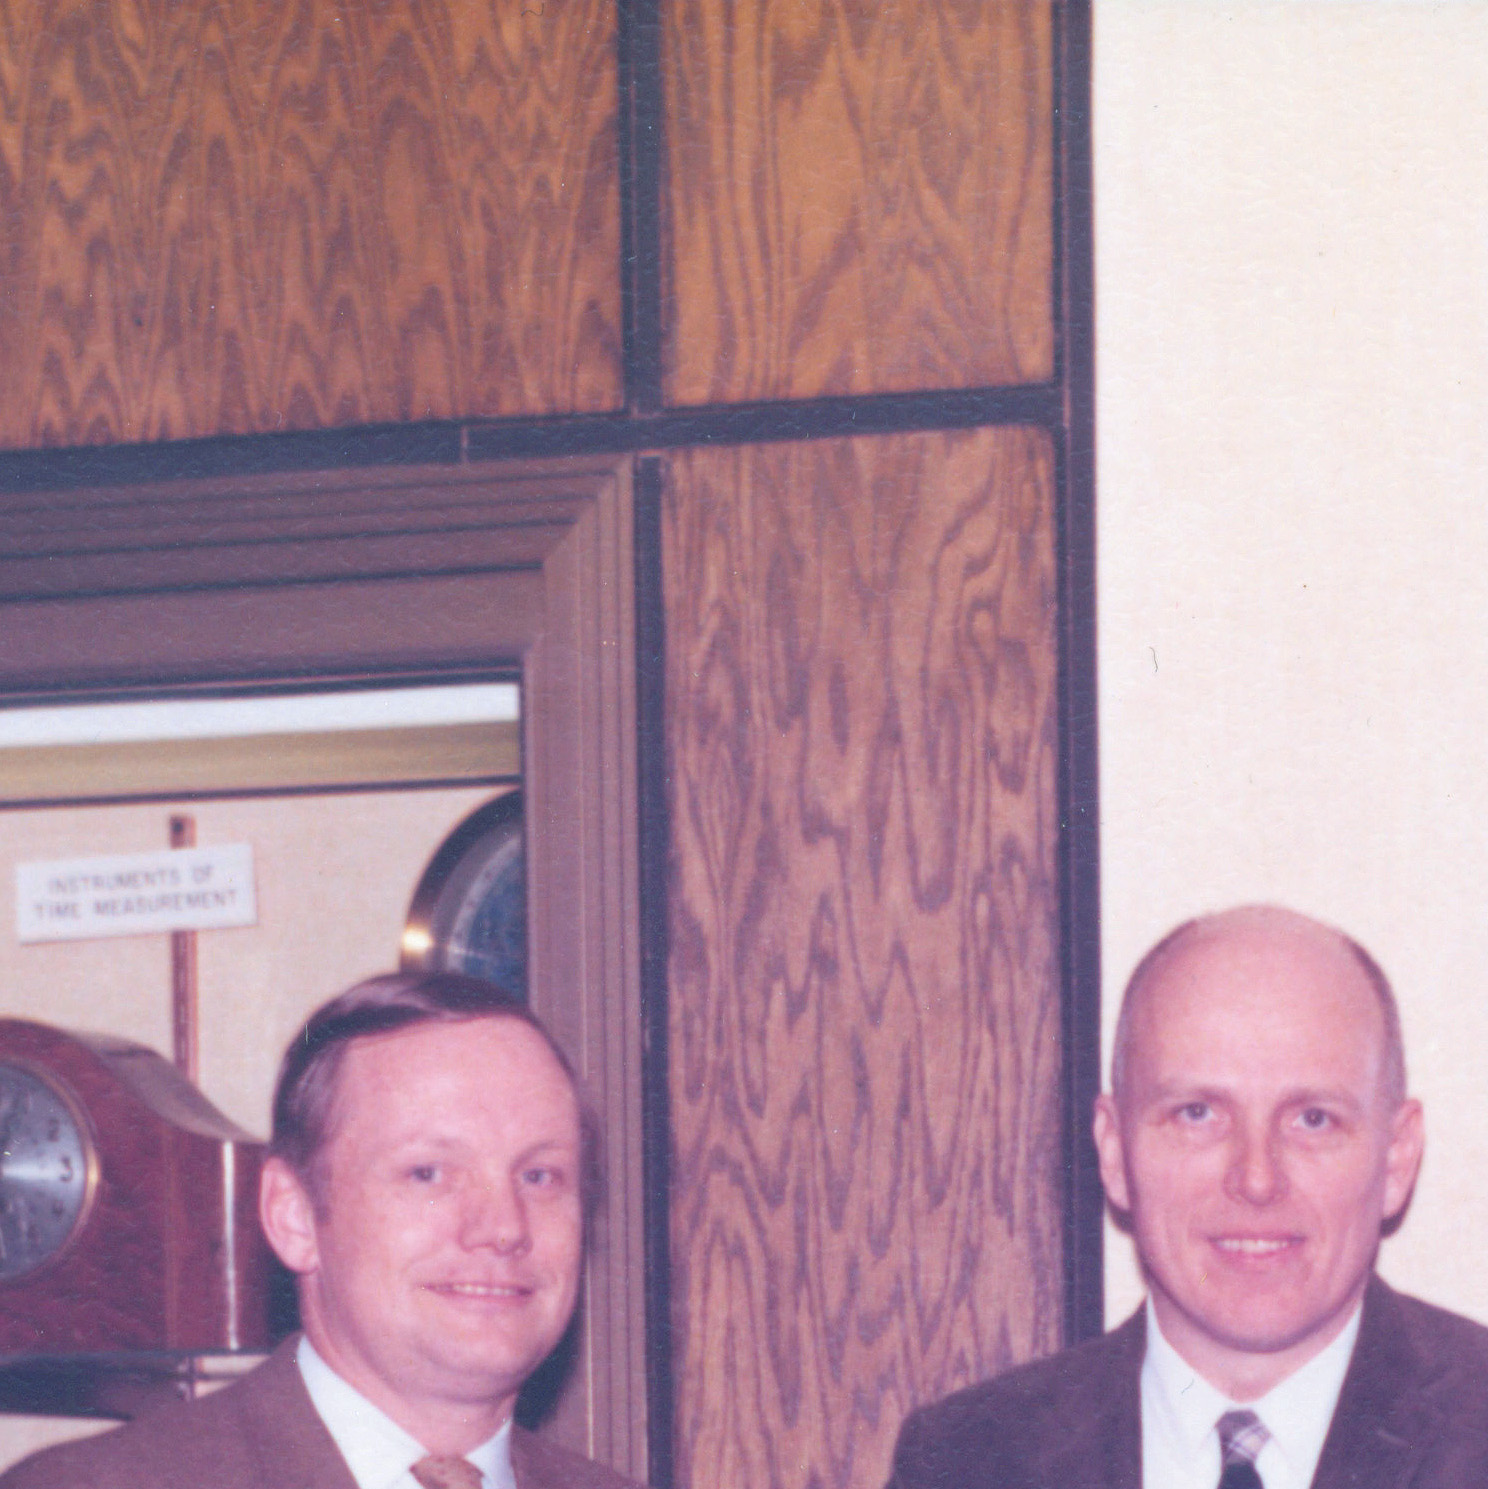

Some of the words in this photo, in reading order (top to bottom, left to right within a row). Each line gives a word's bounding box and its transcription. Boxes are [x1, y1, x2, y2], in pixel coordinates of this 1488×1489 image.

[49, 868, 181, 894] INSTRUMENTS
[192, 864, 213, 884] OF
[34, 902, 81, 919] TIME
[95, 889, 236, 916] MEASUREMENT
[60, 1155, 74, 1182] 3
